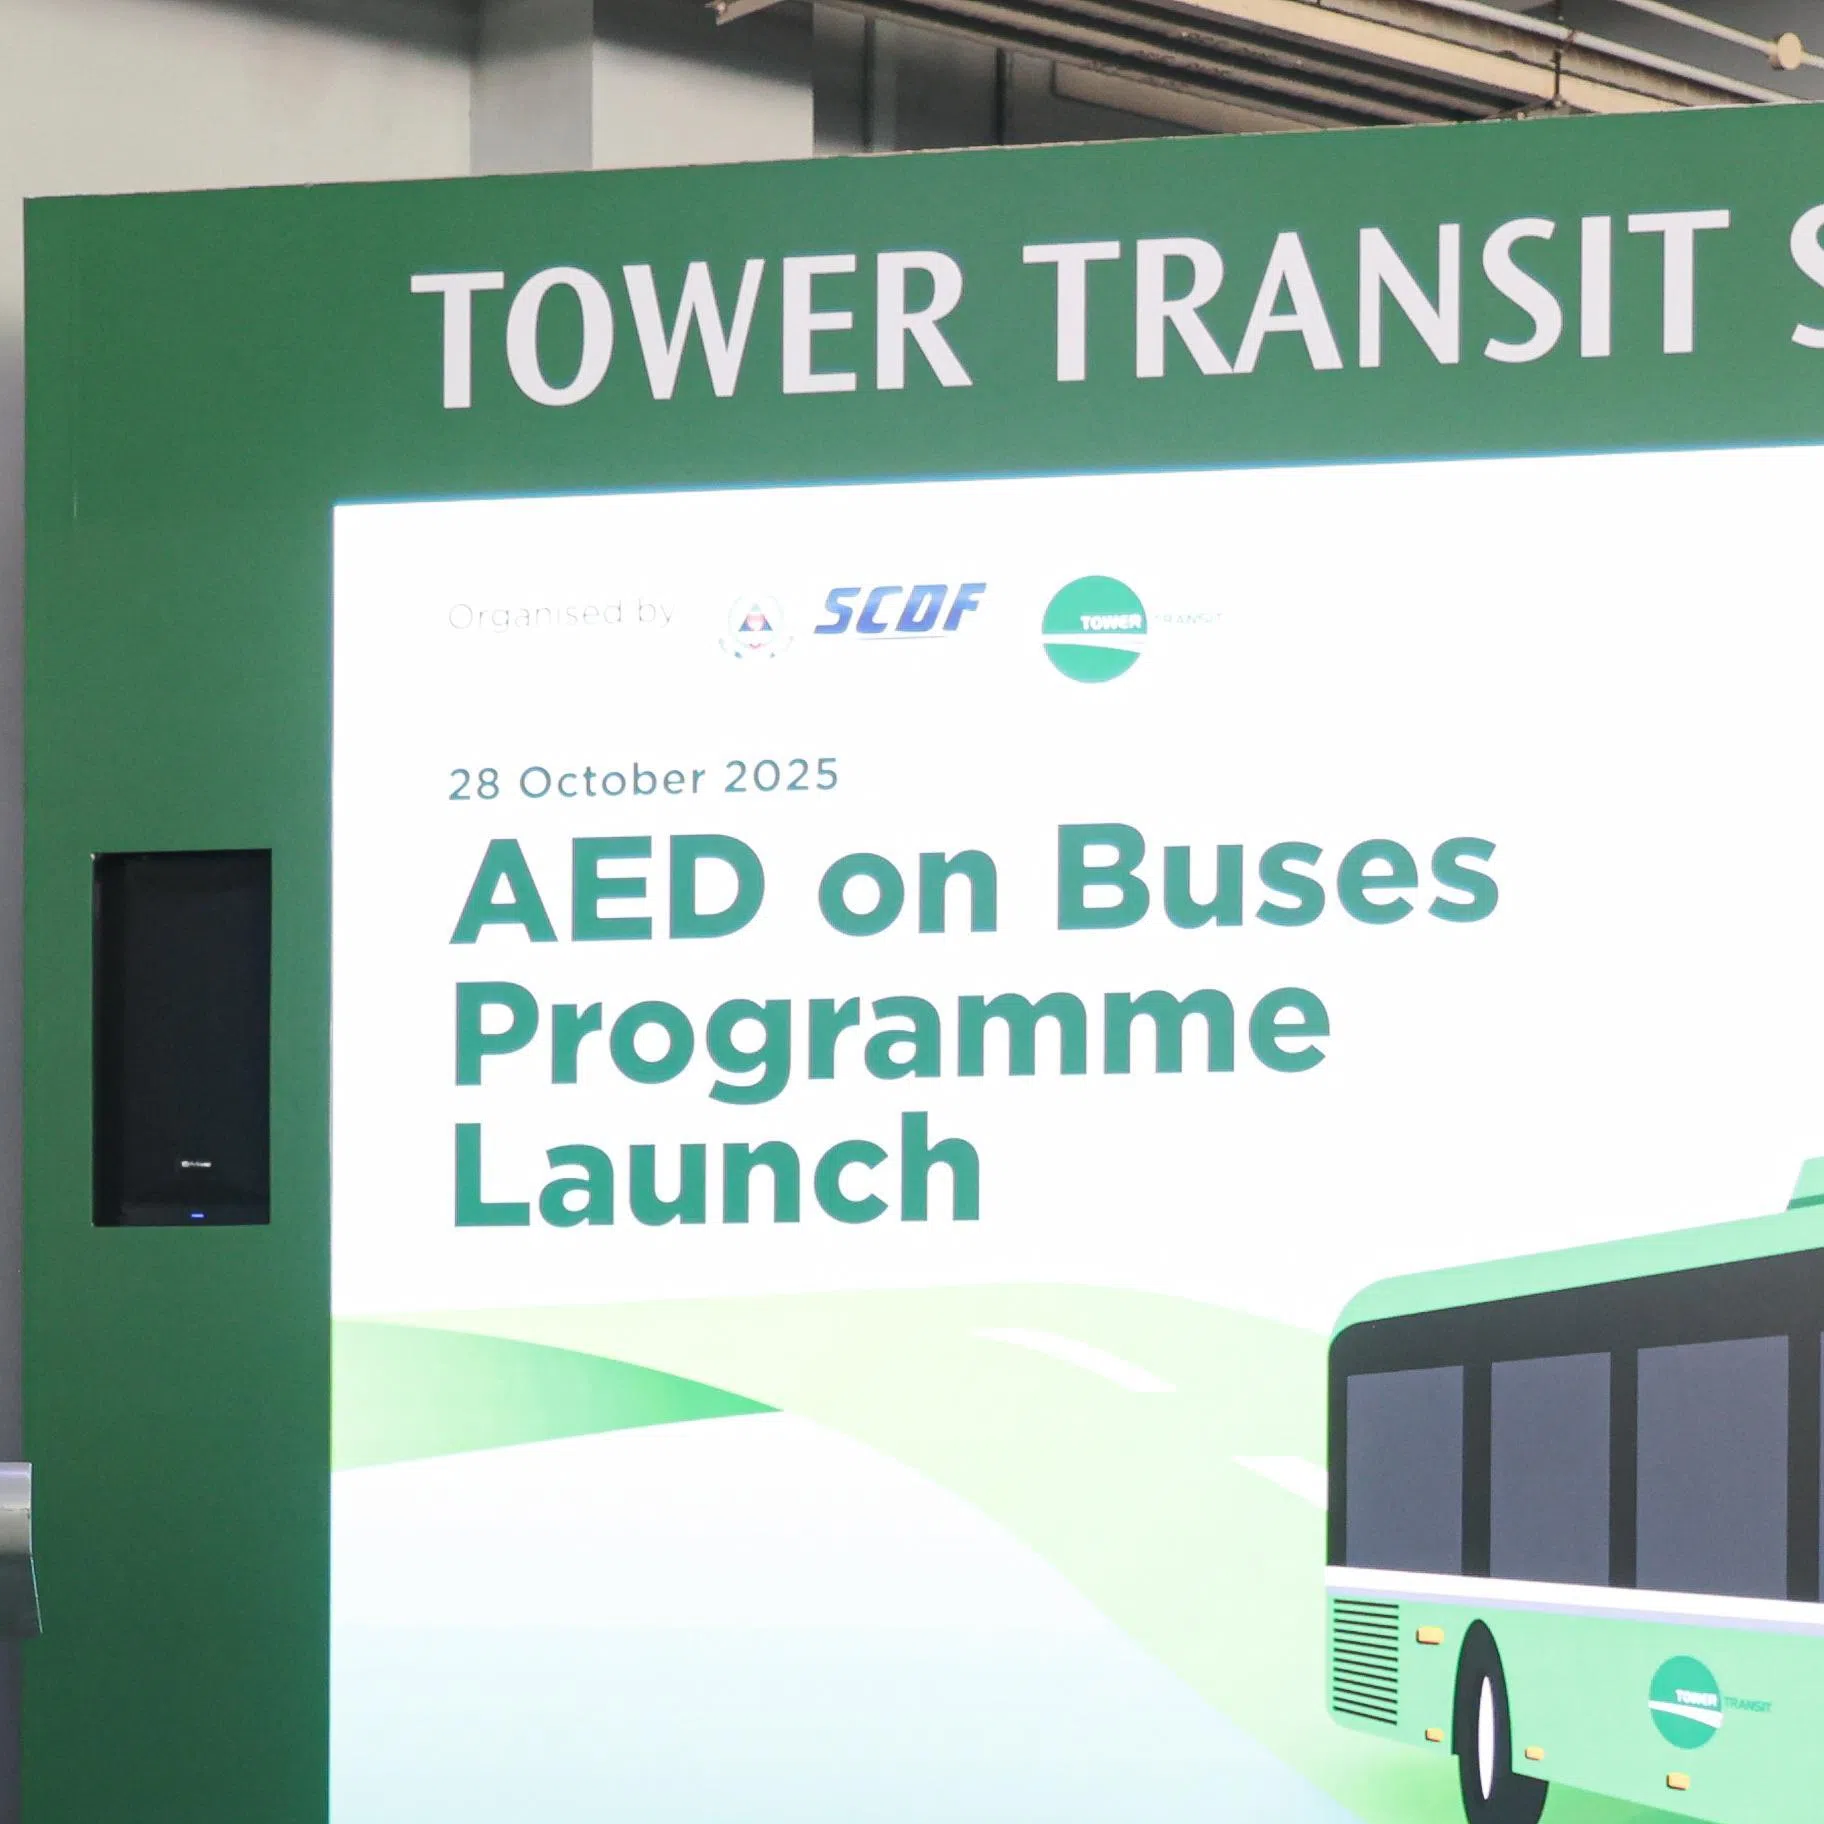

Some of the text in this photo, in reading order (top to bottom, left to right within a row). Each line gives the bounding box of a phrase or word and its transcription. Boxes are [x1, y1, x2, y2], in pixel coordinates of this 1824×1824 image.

[412, 252, 971, 407] TOWER
[1024, 210, 1729, 380] TRANSIT
[448, 595, 675, 634] Organised by
[813, 581, 988, 636] SCDF
[1079, 613, 1143, 631] TOWER
[448, 757, 838, 801] 28 October 2025
[449, 822, 1499, 944] AED on Buses
[455, 981, 1330, 1106] Programme
[454, 1111, 980, 1228] Launch
